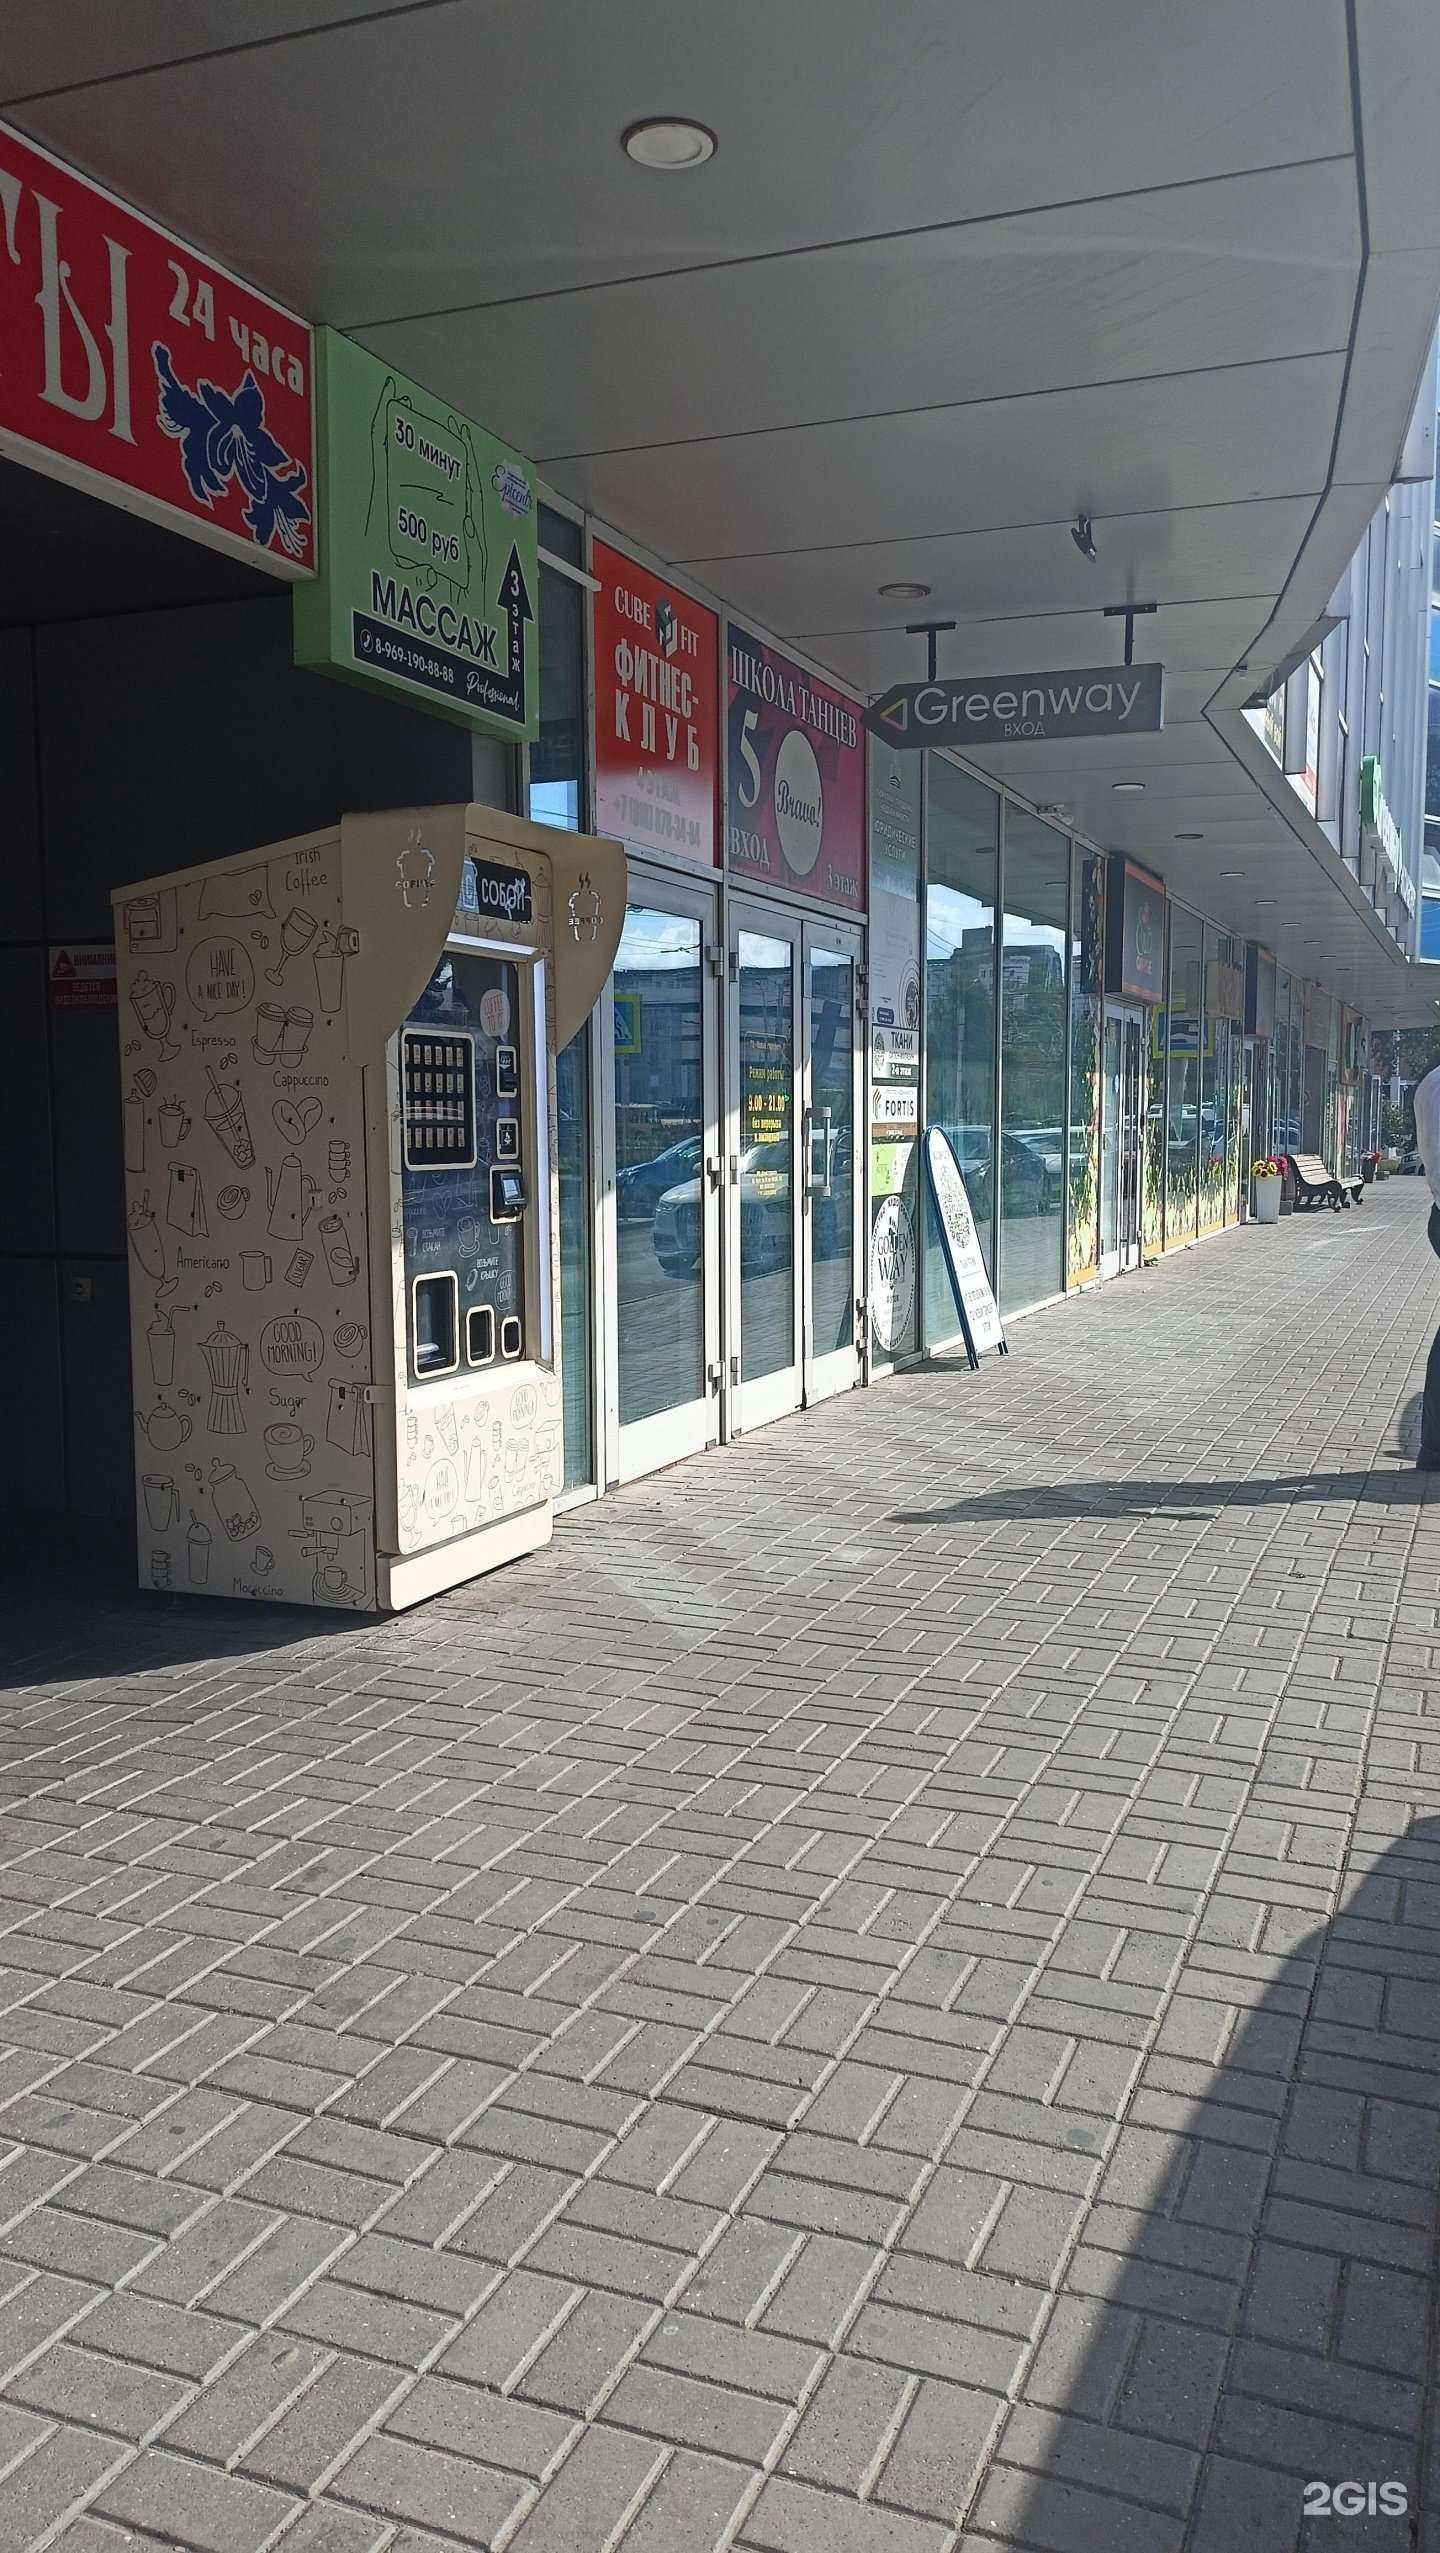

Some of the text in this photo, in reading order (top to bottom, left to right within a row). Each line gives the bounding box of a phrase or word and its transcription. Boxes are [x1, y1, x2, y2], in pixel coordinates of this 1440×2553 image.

[168, 259, 304, 397] 24 часа
[395, 417, 462, 480] 30 минут
[399, 507, 460, 562] 500 руб
[510, 570, 520, 596] 3
[371, 569, 499, 667] МАССАЖ
[614, 586, 699, 657] CUBE FIT
[375, 638, 454, 684] 8-969-190-88-88
[466, 671, 520, 711] Professional
[614, 638, 699, 718] ФИТНЕС-
[731, 645, 857, 749] ШКОЛА ТАНЦЕВ
[914, 681, 1142, 725] Greenway
[1004, 721, 1046, 737] ВХОД
[738, 709, 761, 808] 5
[776, 779, 822, 828] Bravo!
[295, 850, 321, 865] Irish
[730, 827, 770, 872] ВХОД
[285, 868, 328, 896] Coffee
[481, 877, 526, 912] СОБОЙ
[209, 948, 237, 977] HAVE
[191, 1029, 236, 1053] Espresso
[891, 1031, 913, 1050] ТКАНИ
[273, 1070, 329, 1092] Cappuccino
[768, 1094, 785, 1111] 21.00
[885, 1100, 914, 1117] FORTIS
[176, 1246, 229, 1270] Americano
[273, 1321, 302, 1344] GOOD
[267, 1341, 317, 1364] MORNING!
[269, 1387, 307, 1417] Sugar
